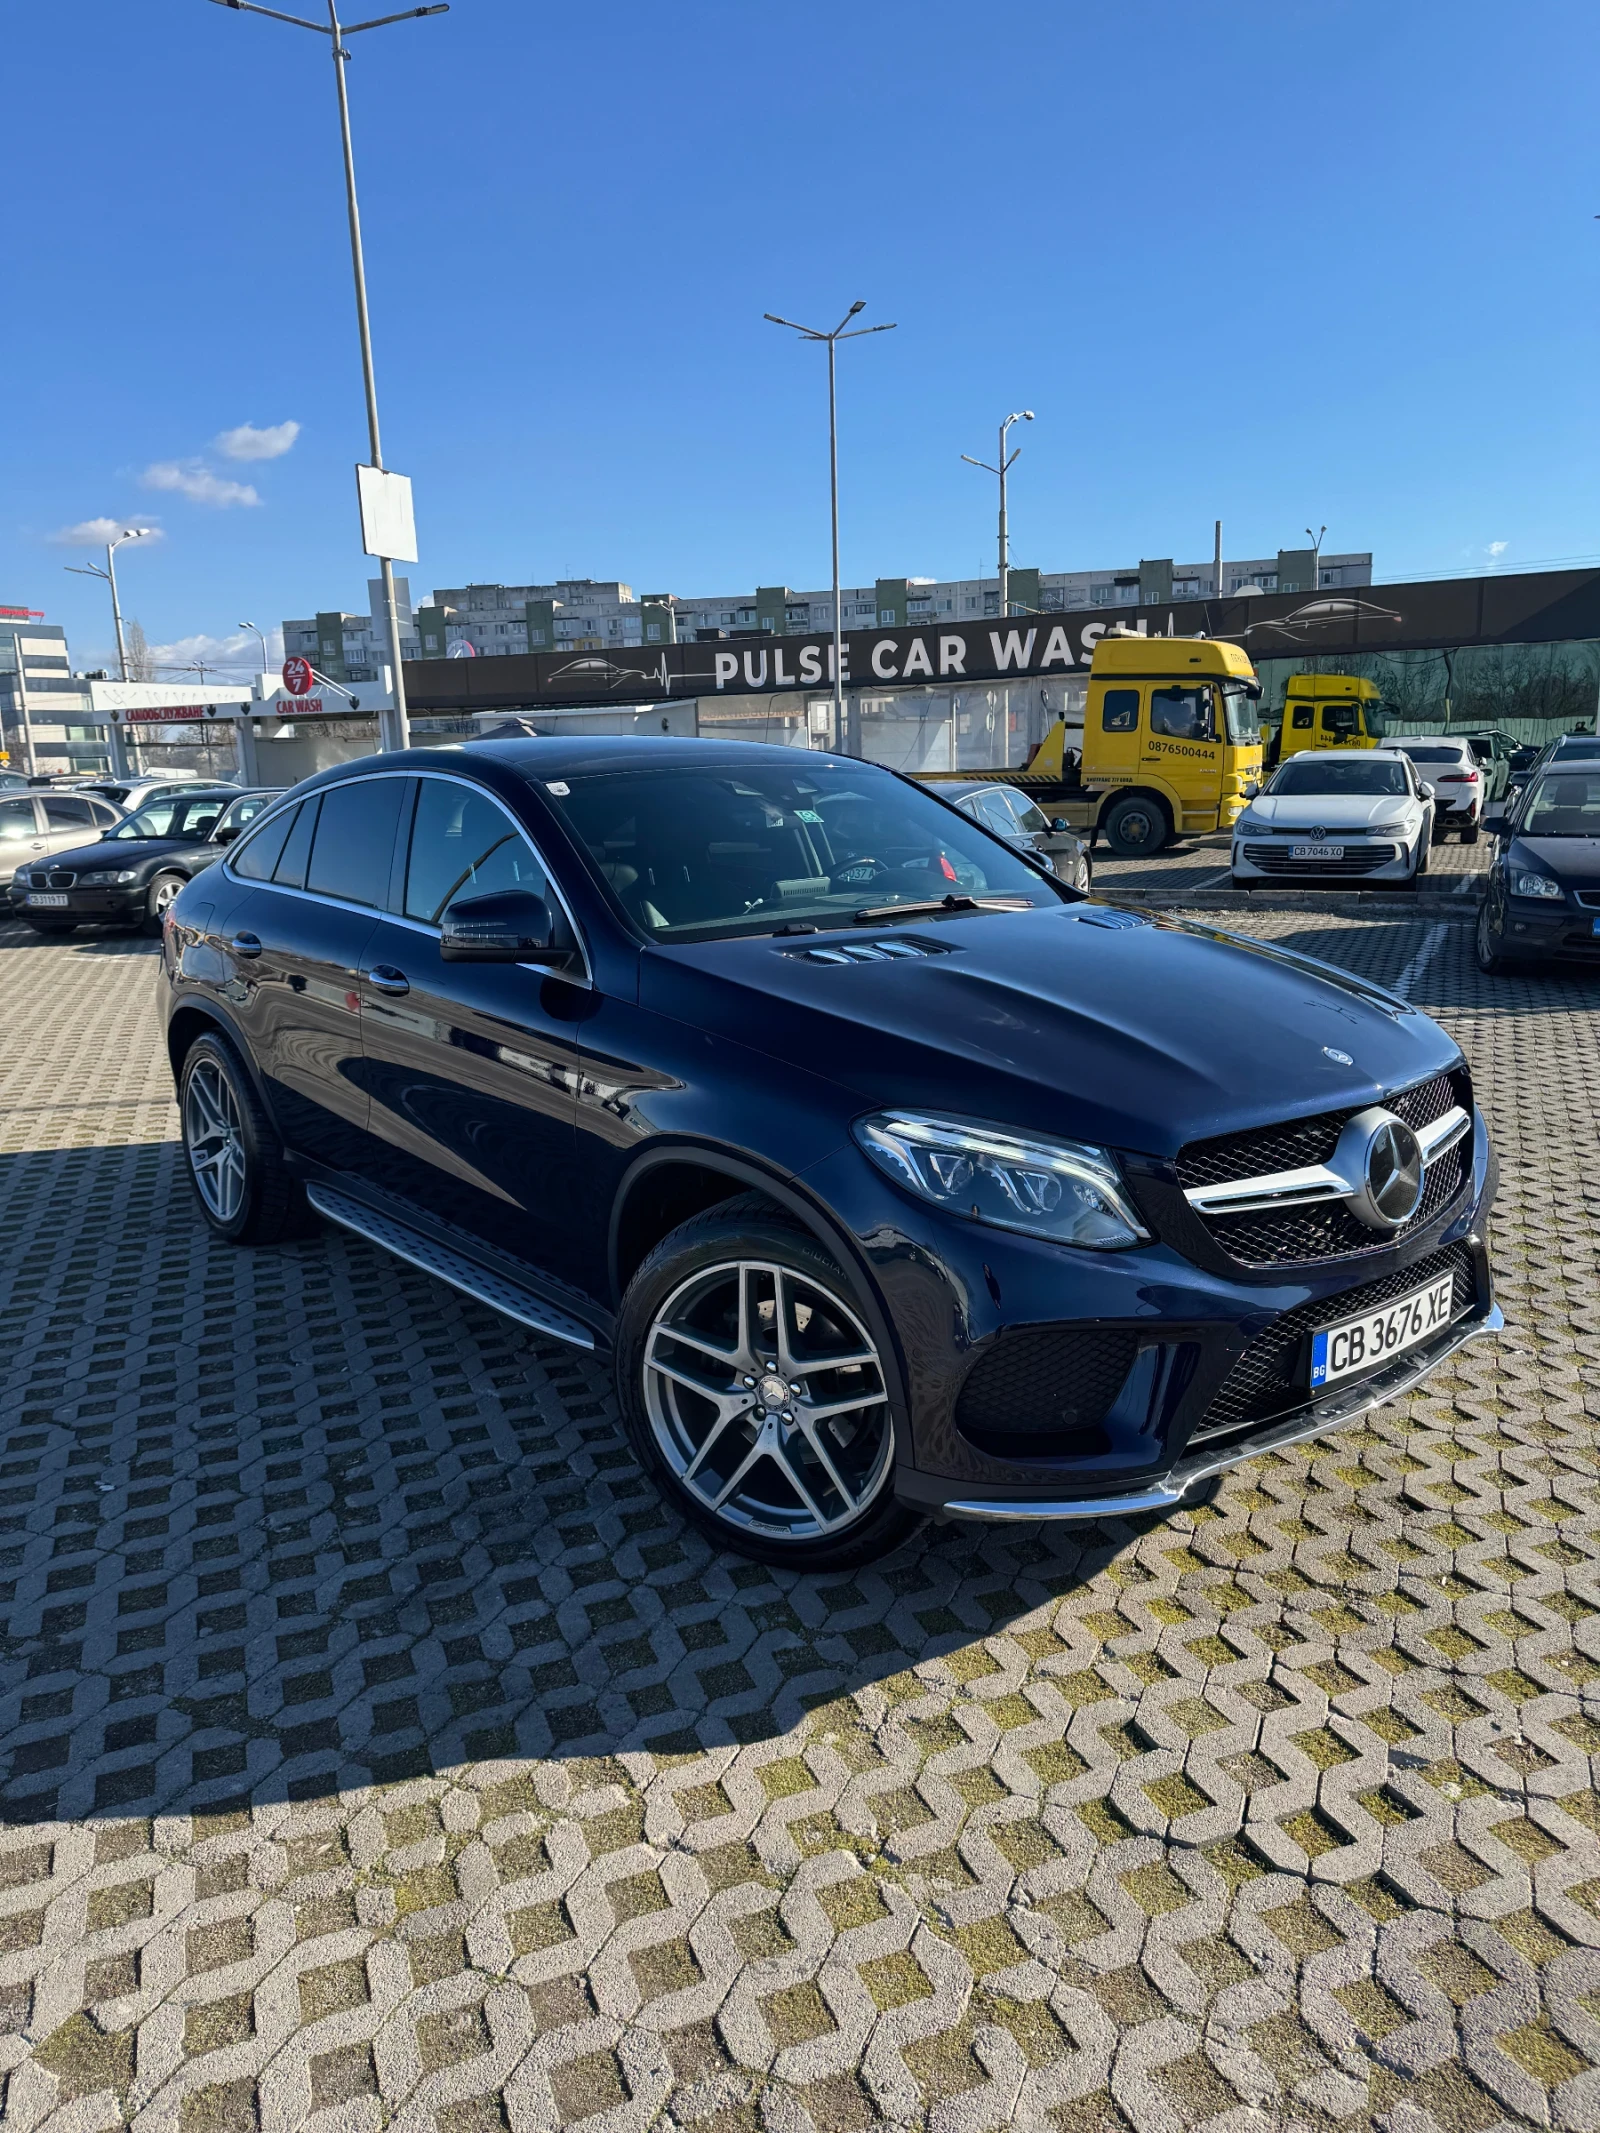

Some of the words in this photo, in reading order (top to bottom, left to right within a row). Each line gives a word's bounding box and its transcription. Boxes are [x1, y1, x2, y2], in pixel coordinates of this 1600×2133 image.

[286, 659, 305, 675] 24
[714, 640, 851, 690] PULSE
[871, 634, 967, 679] CAR
[292, 678, 301, 693] 7
[125, 704, 205, 722] САМООБСЛУЖВАНЕ
[276, 700, 294, 714] CAR
[295, 698, 323, 713] WASH
[1148, 740, 1215, 760] 0876500444
[1294, 846, 1306, 856] CB
[1307, 847, 1329, 856] 7046
[1313, 1364, 1326, 1380] BG
[1331, 1325, 1366, 1373] CB
[1369, 1298, 1423, 1357] 3676
[1426, 1281, 1451, 1329] XE
